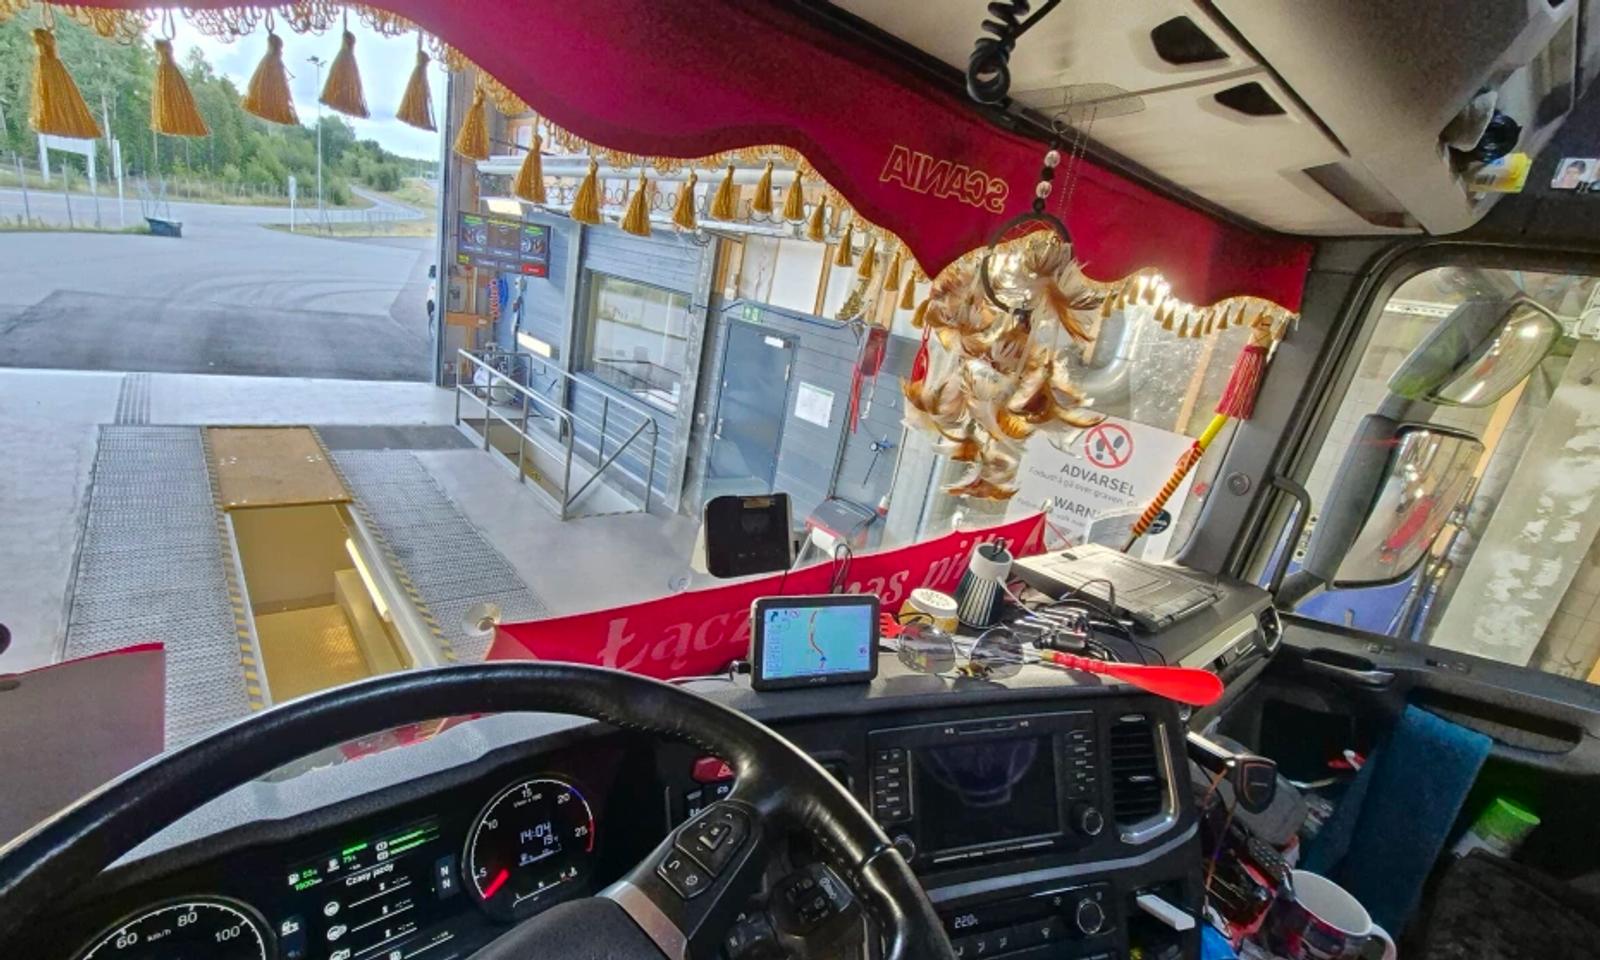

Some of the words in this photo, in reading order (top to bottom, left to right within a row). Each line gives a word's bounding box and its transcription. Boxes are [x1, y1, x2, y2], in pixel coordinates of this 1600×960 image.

[1060, 464, 1135, 496] ADVARSEL
[1054, 495, 1100, 519] WARN
[597, 608, 751, 671] Łącz
[522, 787, 532, 798] 15
[557, 793, 570, 804] 20
[488, 819, 498, 830] 10
[574, 826, 588, 838] 25
[520, 822, 552, 844] 14:04
[480, 866, 488, 877] 5
[177, 912, 198, 928] 80
[116, 932, 138, 949] 60
[214, 925, 240, 942] 100
